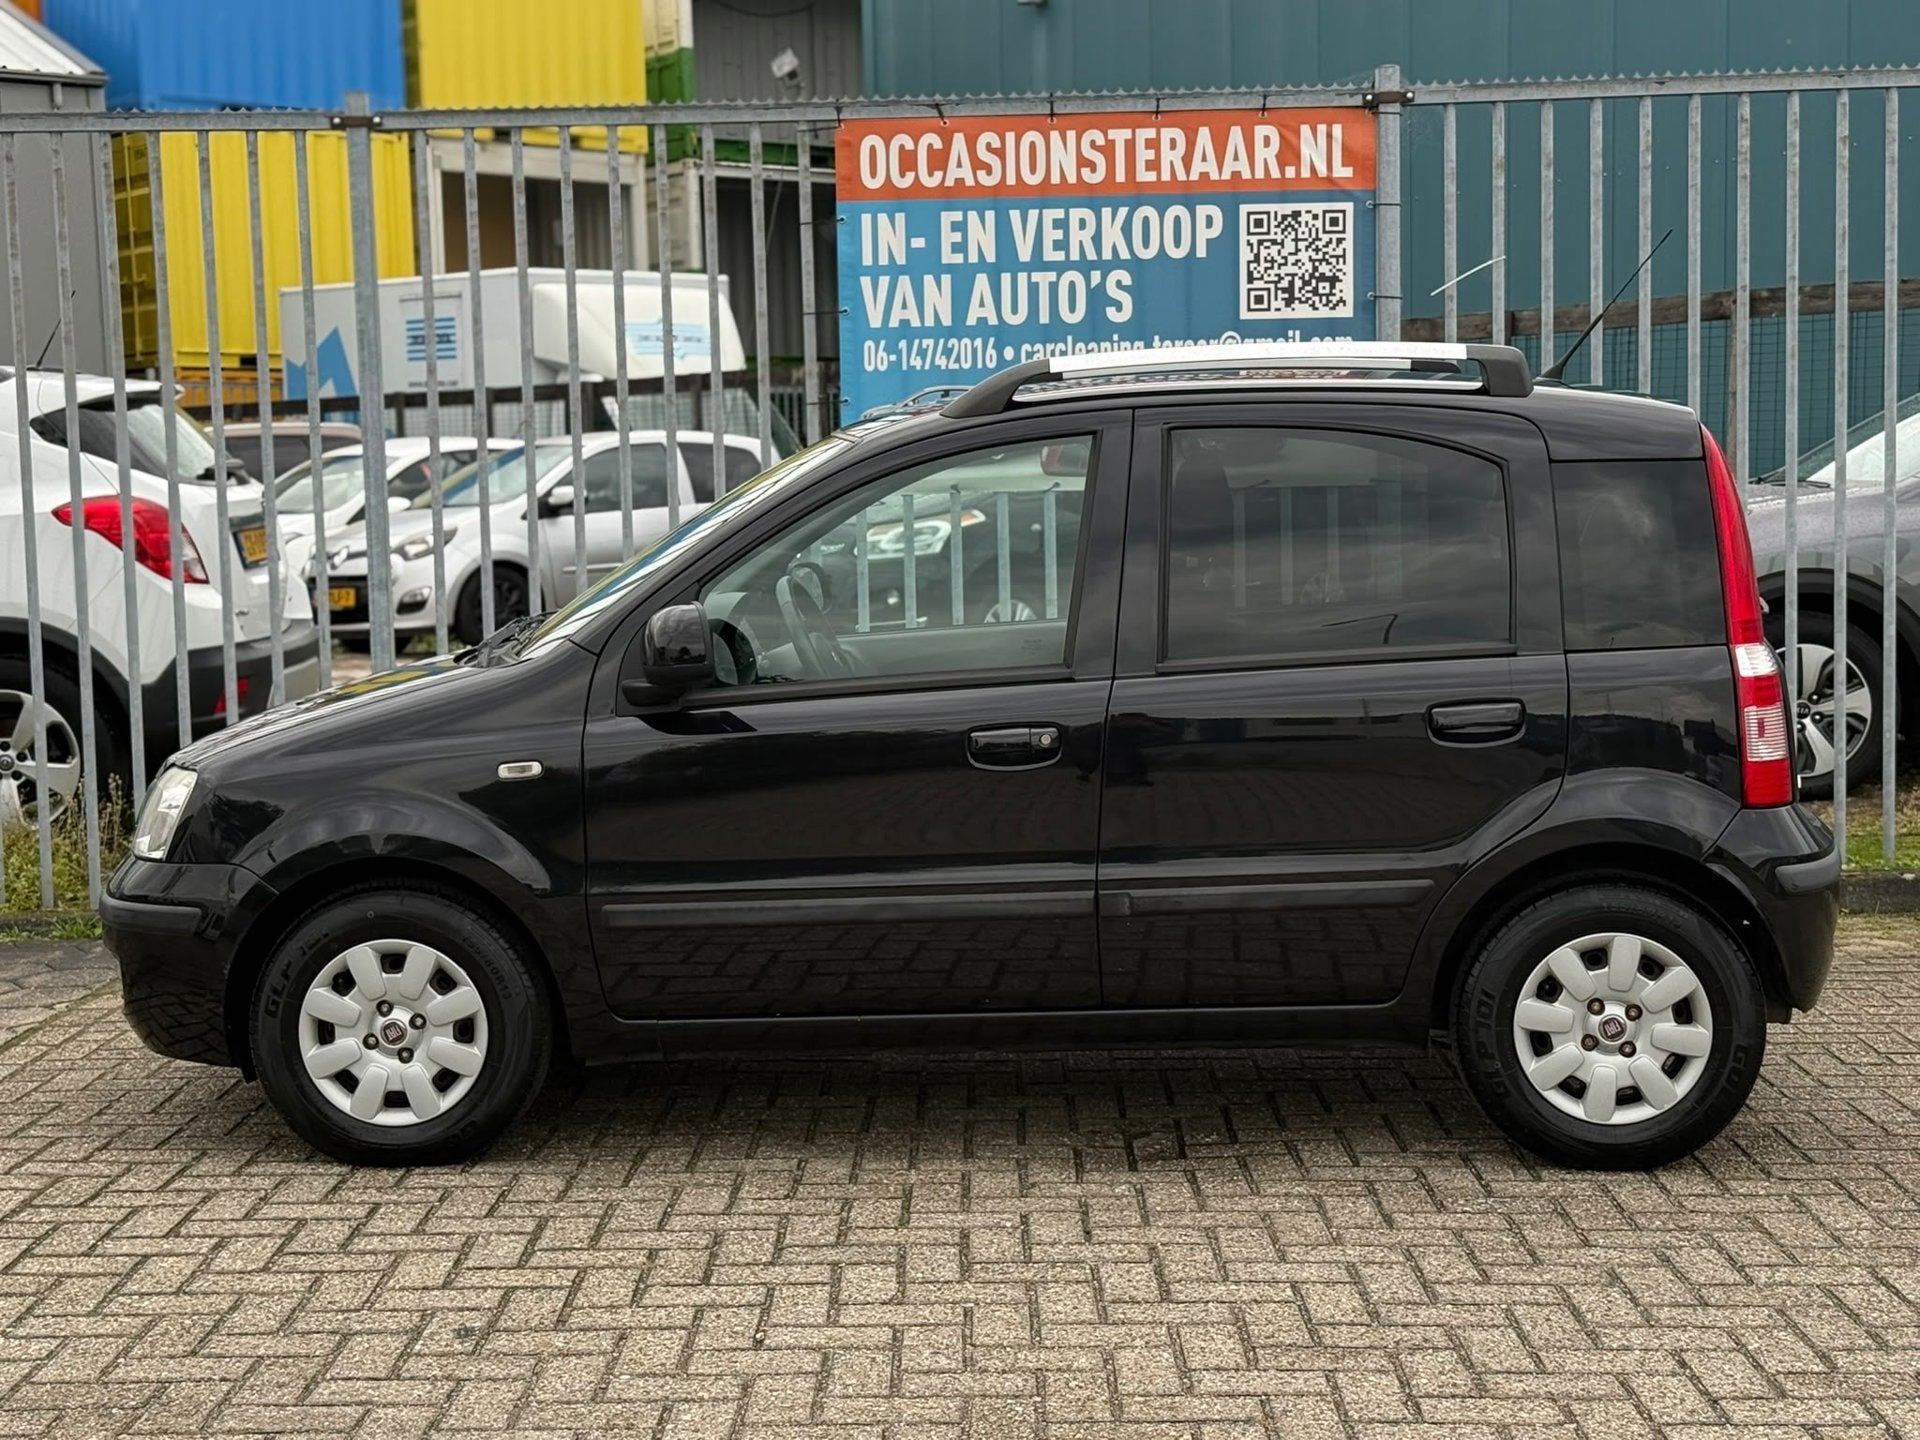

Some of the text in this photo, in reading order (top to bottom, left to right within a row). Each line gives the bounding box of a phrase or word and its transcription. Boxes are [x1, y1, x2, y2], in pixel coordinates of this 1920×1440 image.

[860, 123, 1354, 189] OCCASIONSTERAAR.NL
[861, 204, 1224, 266] IN- EN VERKOOP
[859, 269, 1133, 329] VAN AUTO'S
[863, 337, 997, 372] 06-14742016
